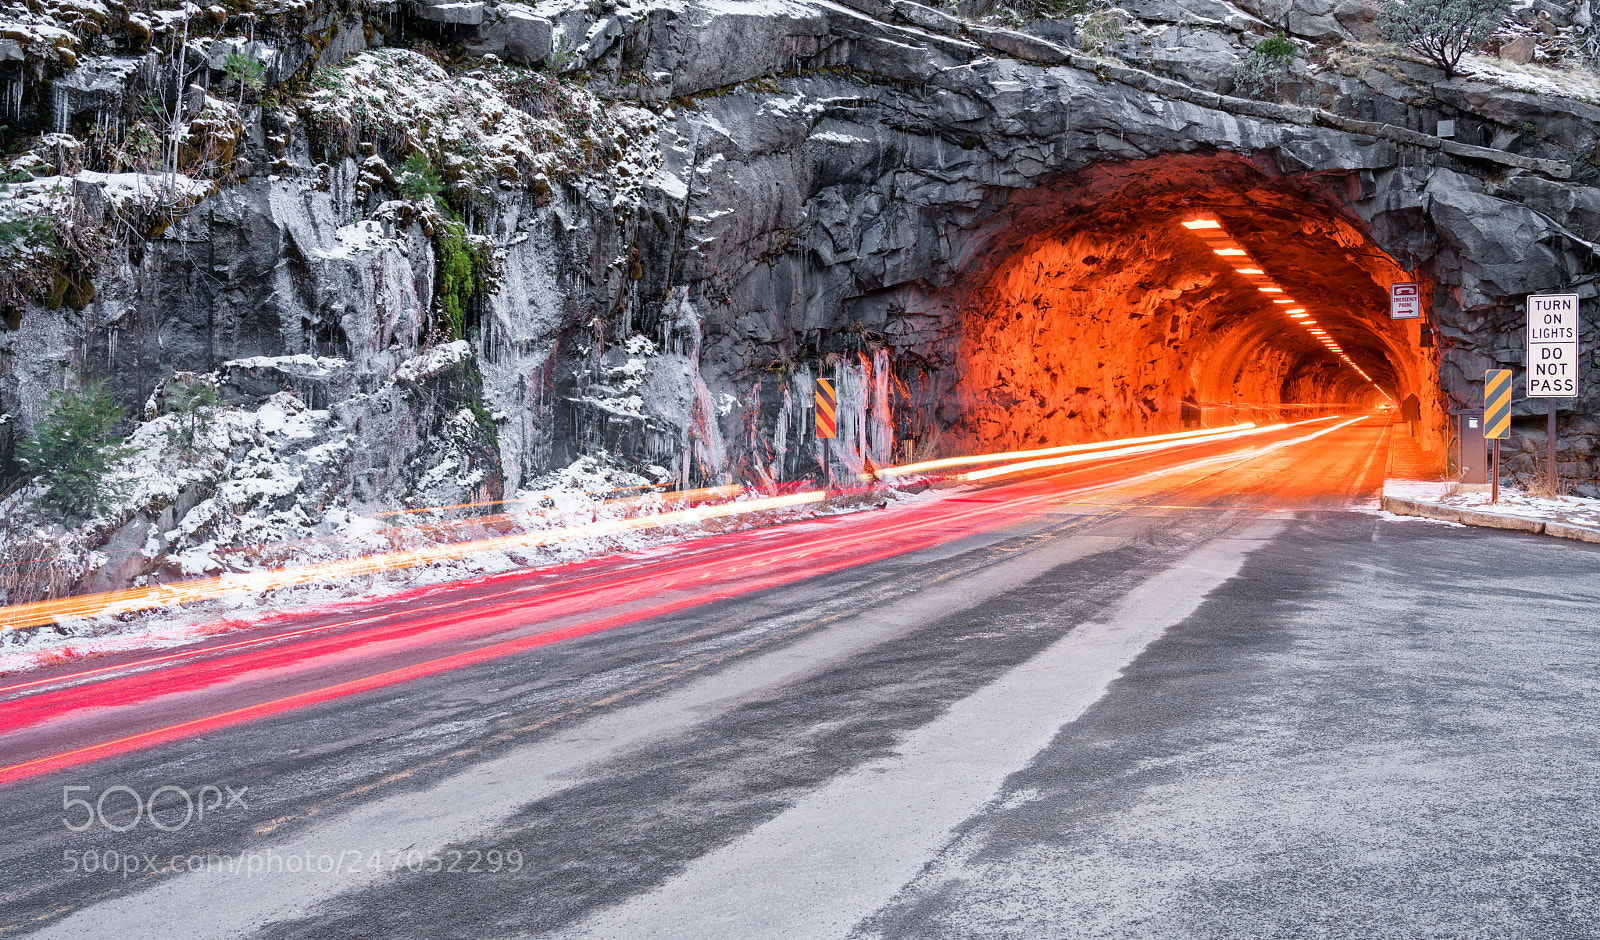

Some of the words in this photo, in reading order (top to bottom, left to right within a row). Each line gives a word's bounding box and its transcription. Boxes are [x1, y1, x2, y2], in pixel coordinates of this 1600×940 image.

[1535, 300, 1571, 311] TURN
[1544, 314, 1562, 325] ON
[1532, 328, 1573, 339] LIGHTS
[1542, 348, 1562, 360] DO
[1536, 363, 1568, 376] NOT
[1530, 379, 1574, 392] PASS
